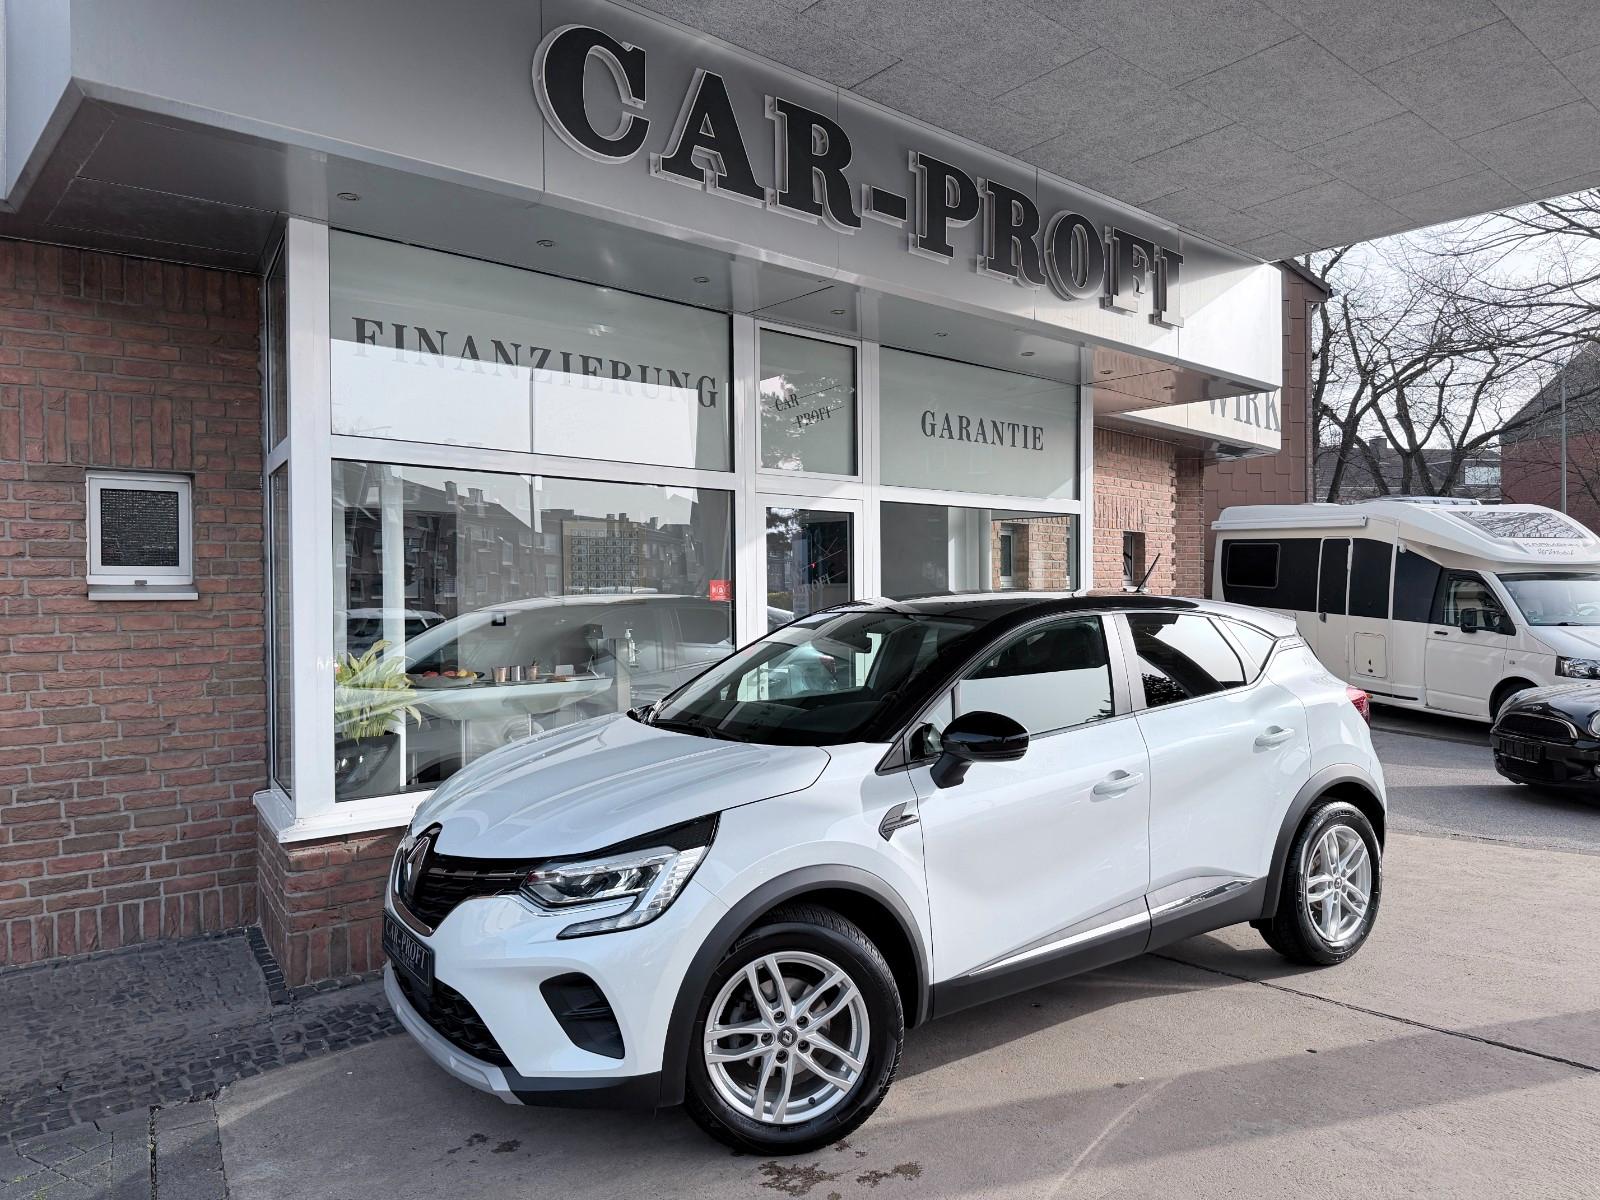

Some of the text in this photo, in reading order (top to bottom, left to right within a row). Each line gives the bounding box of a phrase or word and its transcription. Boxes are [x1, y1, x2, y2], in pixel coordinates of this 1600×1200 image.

[532, 23, 1185, 330] CAR-PROFI
[351, 316, 719, 409] FINANZIERUNG
[775, 393, 800, 412] CAR
[796, 405, 831, 428] PROFI
[921, 409, 1044, 451] GARANTIE
